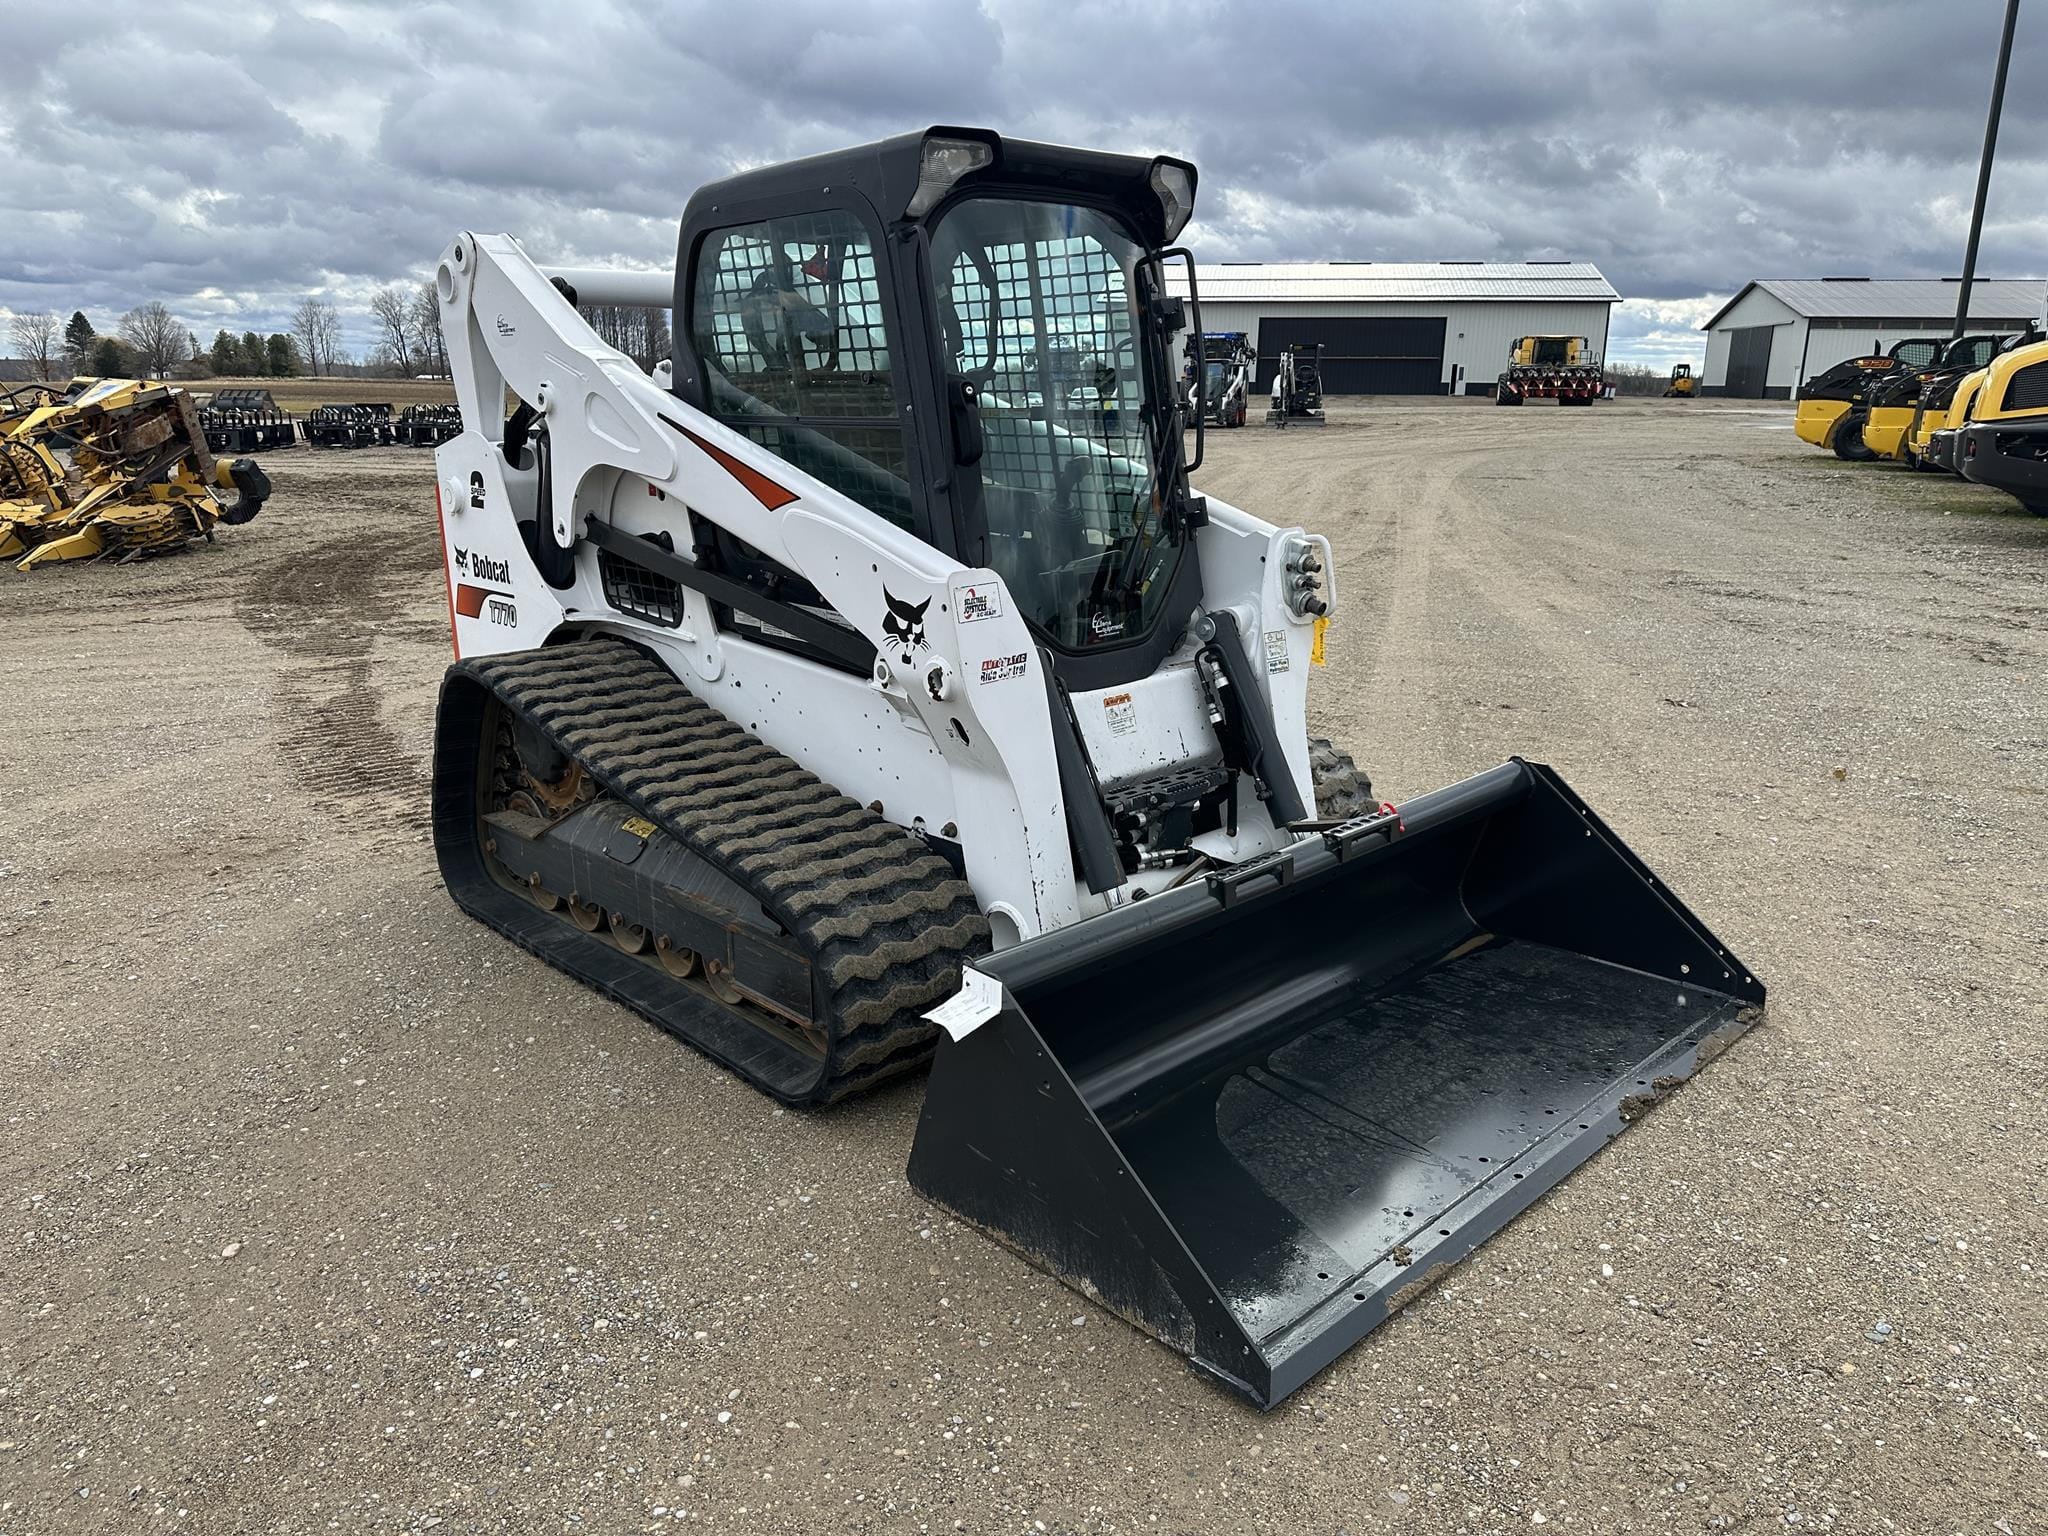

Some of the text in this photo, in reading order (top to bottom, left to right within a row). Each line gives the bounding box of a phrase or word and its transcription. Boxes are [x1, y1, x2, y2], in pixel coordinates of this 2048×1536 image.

[470, 470, 485, 509] 2
[470, 486, 486, 497] SPEED
[472, 553, 510, 585] Bobcat
[489, 600, 518, 628] T770
[964, 602, 987, 615] JOYSTICKS
[982, 652, 1028, 671] AUTOATIC
